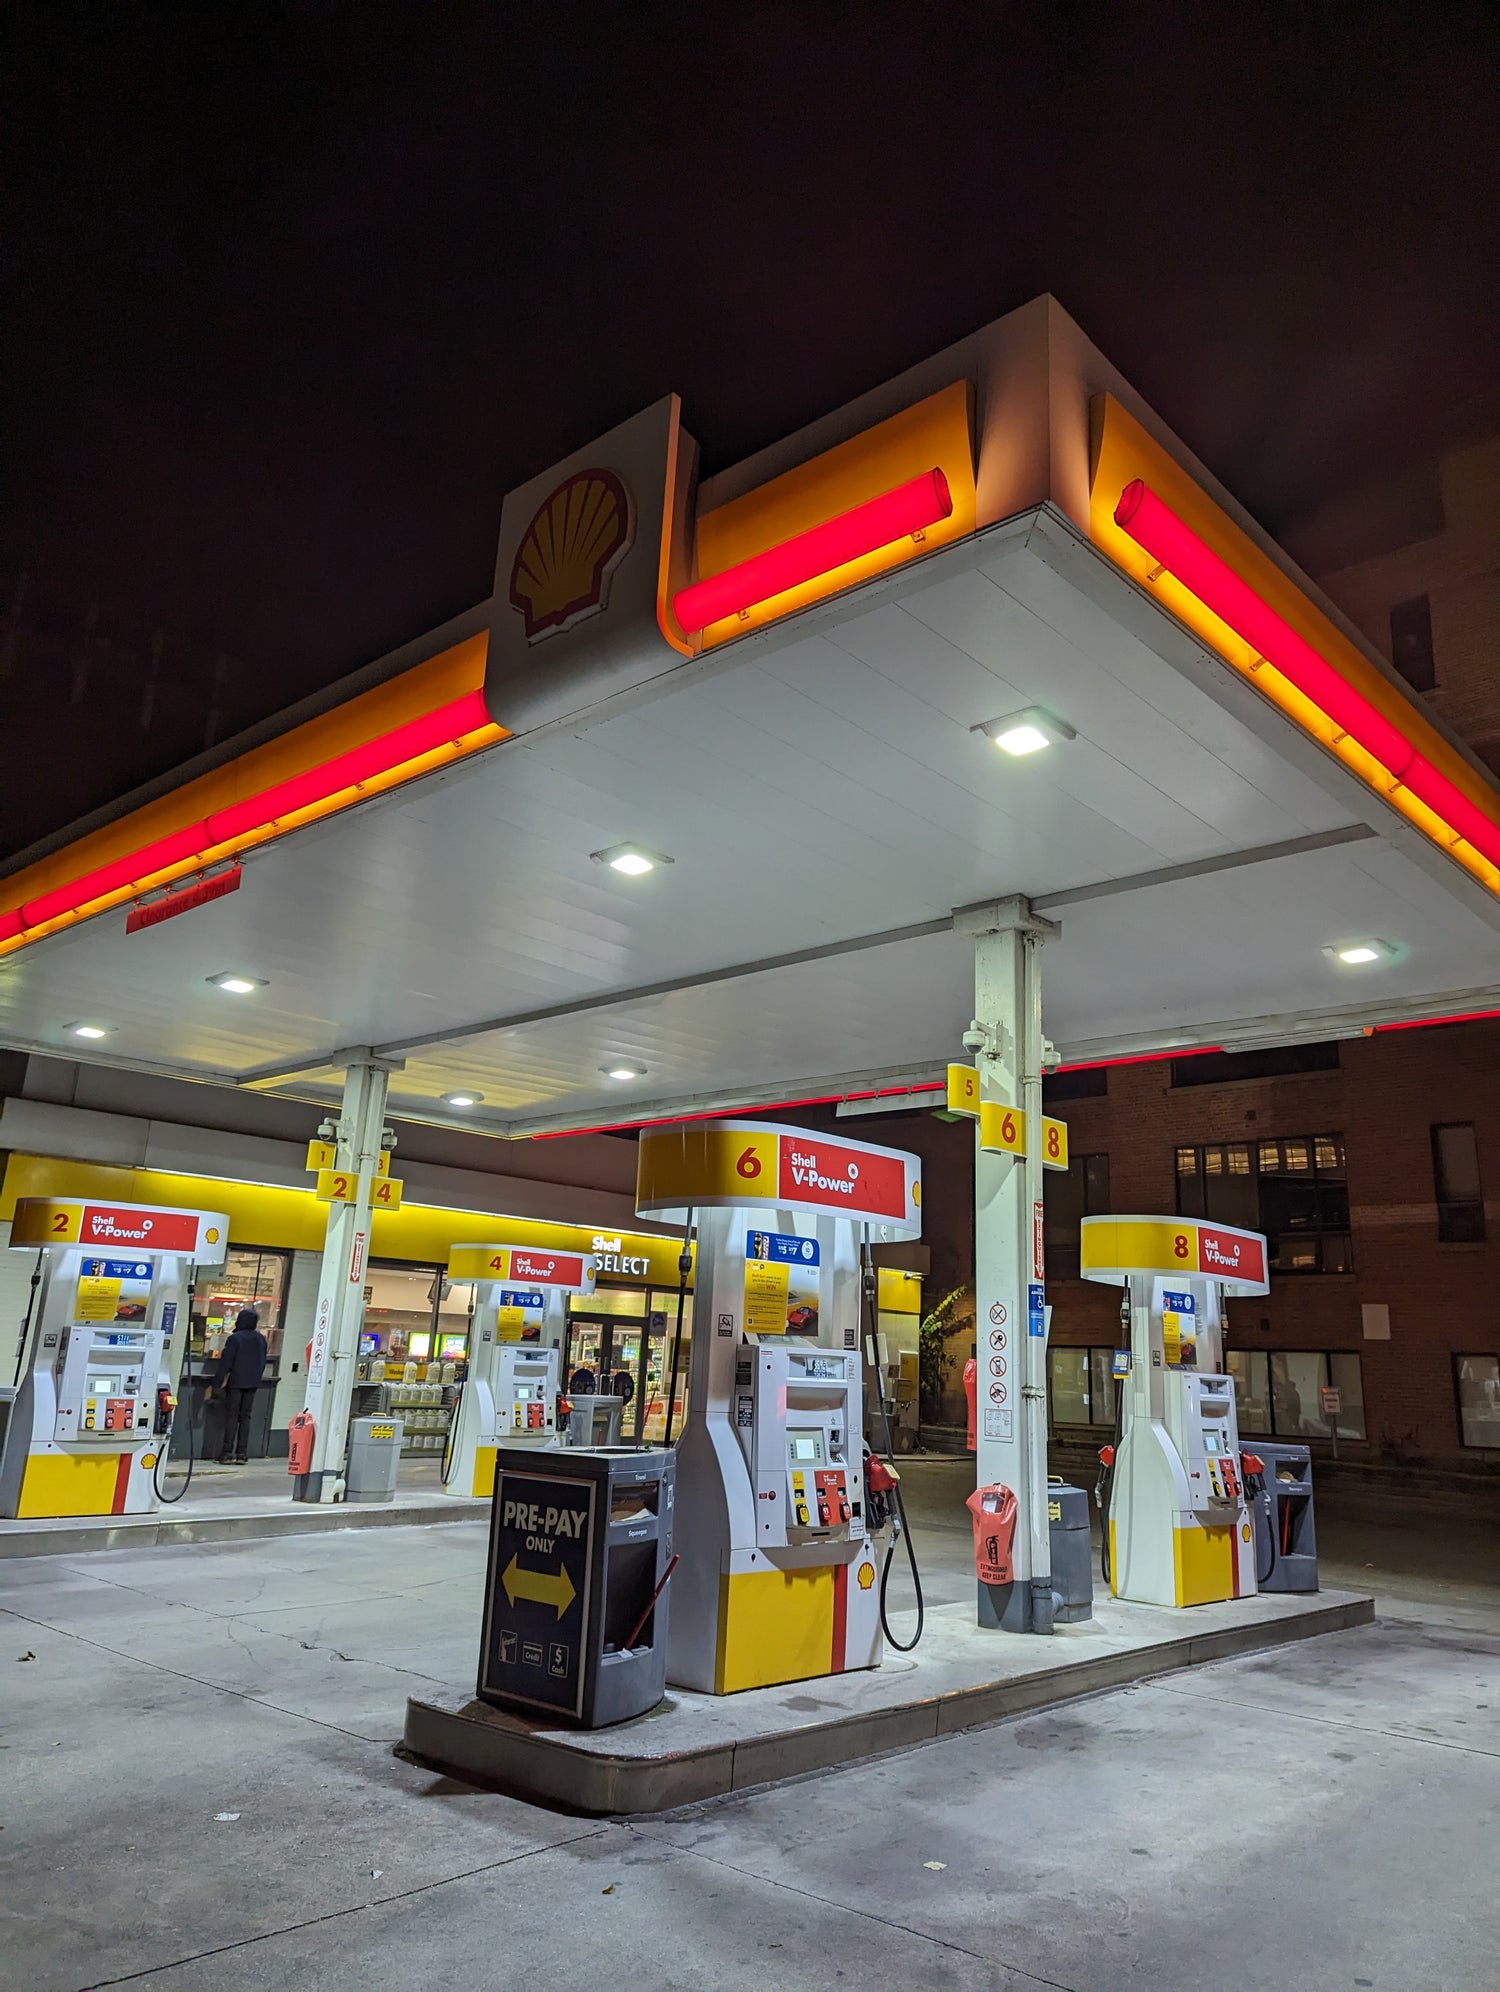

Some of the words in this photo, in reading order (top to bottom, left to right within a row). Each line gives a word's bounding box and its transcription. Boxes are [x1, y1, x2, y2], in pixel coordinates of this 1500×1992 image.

[965, 1080, 973, 1096] 5
[1002, 1113, 1016, 1143] 6
[1048, 1127, 1059, 1157] 8
[320, 1151, 326, 1162] 1
[736, 1147, 762, 1179] 6
[791, 1152, 816, 1169] Shell
[332, 1177, 347, 1198] 2
[791, 1166, 855, 1194] V-Power
[376, 1183, 391, 1202] 4
[52, 1213, 69, 1233] 2
[91, 1215, 115, 1227] Shell
[91, 1223, 148, 1240] V-Power
[592, 1236, 621, 1252] Shell
[1174, 1234, 1189, 1259] 8
[1204, 1239, 1219, 1250] Shell
[489, 1256, 502, 1271] 4
[516, 1257, 531, 1267] Shell
[593, 1253, 649, 1275] SELECT
[1205, 1249, 1239, 1268] V-Power
[516, 1265, 552, 1278] V-Power
[503, 1500, 588, 1539] PRE-PAY
[628, 1529, 648, 1538] Squeegee
[525, 1535, 556, 1554] ONLY
[551, 1665, 565, 1675] Cash
